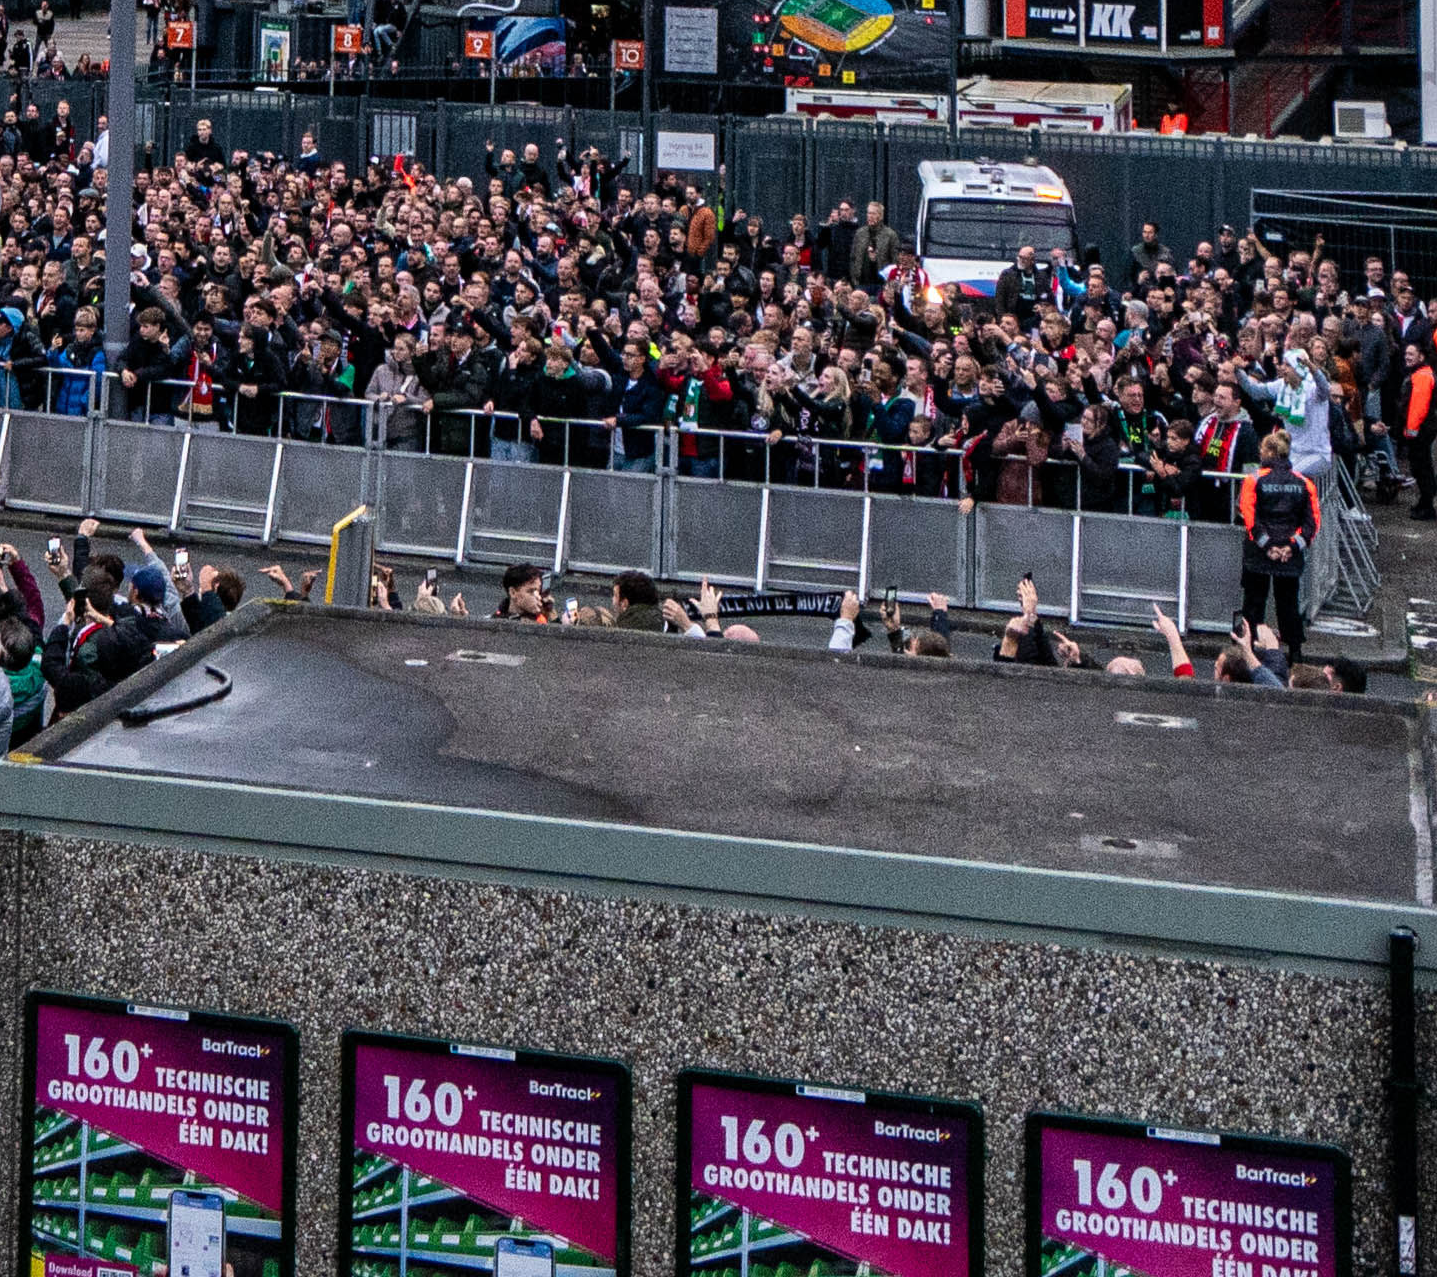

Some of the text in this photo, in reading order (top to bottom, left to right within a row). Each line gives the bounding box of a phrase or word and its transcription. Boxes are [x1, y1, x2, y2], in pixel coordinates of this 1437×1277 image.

[175, 28, 185, 42] 7
[1089, 3, 1136, 38] KK
[343, 33, 353, 47] 8
[473, 39, 483, 54] 9
[621, 48, 640, 63] 10
[154, 1066, 270, 1101] TECHNISCHE
[47, 1079, 269, 1127] GROOTHANDELS ONDER
[179, 1117, 268, 1155] ÉÉN DAK!
[479, 1110, 601, 1145] TECHNISCHE
[366, 1122, 600, 1173] GROOTHANDELS ONDER
[505, 1164, 600, 1201] ÉÉN DAK!
[822, 1151, 951, 1189] TECHNISCHE
[703, 1164, 951, 1216] GROOTHANDELS ONDER
[850, 1206, 951, 1245] ÉÉN DAK!
[1181, 1196, 1318, 1235] TECHNISCHE
[1056, 1209, 1319, 1263] GROOTHANDELS ONDER
[48, 1261, 93, 1277] Download
[1212, 1252, 1252, 1277] ÉÉN
